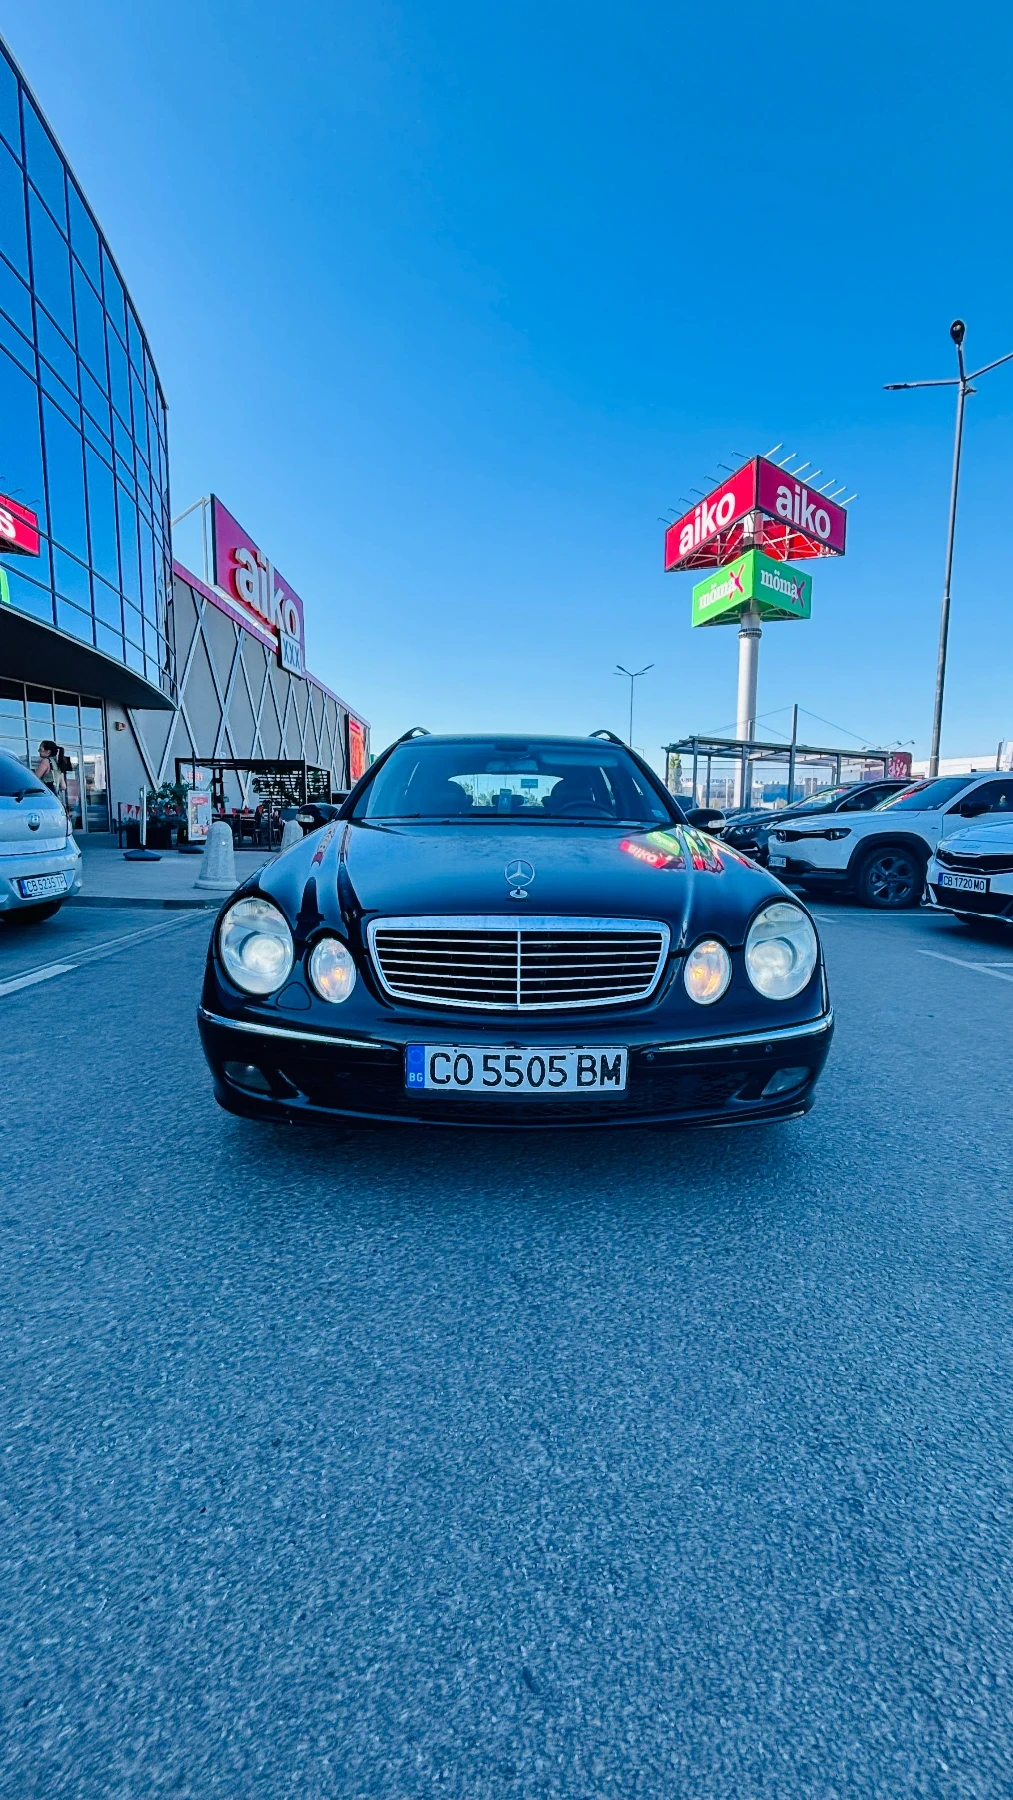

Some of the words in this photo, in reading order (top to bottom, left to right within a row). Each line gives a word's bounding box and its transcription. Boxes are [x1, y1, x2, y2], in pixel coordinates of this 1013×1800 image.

[679, 492, 736, 555] aiko
[775, 485, 831, 539] aiko
[234, 547, 300, 641] aiko
[26, 880, 38, 892] CB
[944, 875, 953, 886] CB
[955, 877, 972, 889] 1720
[974, 880, 985, 891] MO
[409, 1072, 423, 1082] BG
[429, 1052, 474, 1085] CO
[482, 1054, 568, 1087] 5505
[576, 1054, 622, 1087] BM
